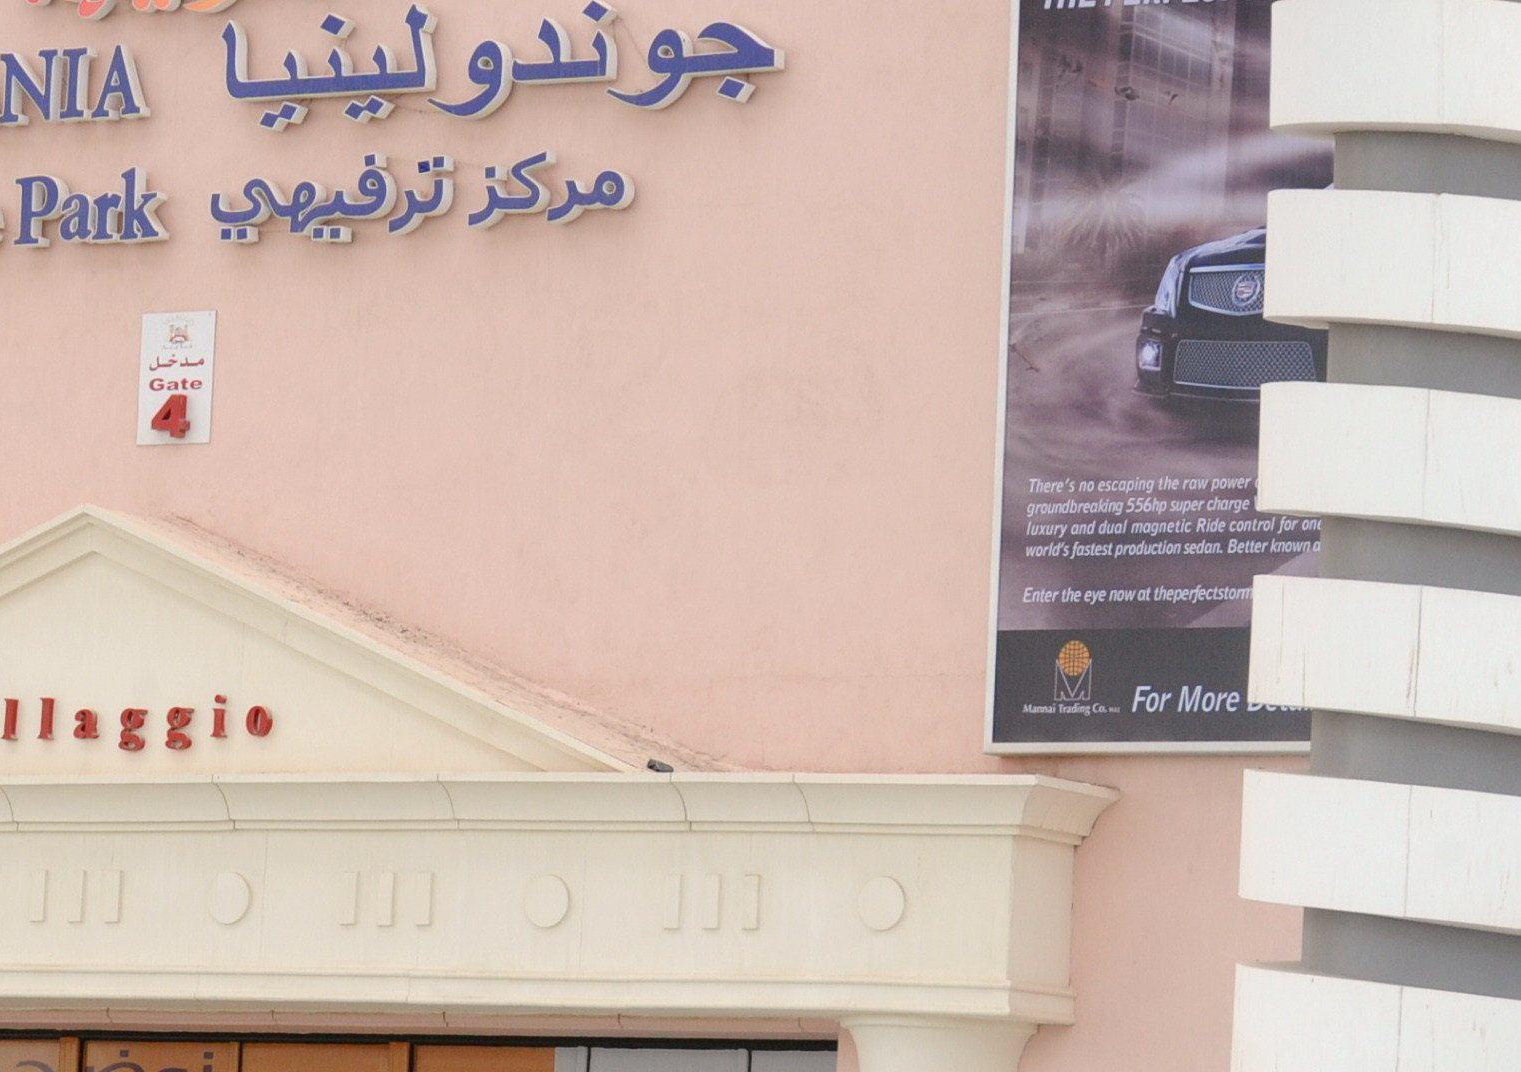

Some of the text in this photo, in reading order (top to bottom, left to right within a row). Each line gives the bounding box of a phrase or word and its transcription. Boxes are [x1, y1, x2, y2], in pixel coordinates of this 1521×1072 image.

[222, 0, 782, 129] جوندولينيا
[210, 150, 634, 242] مركز ترفيهي
[14, 168, 168, 248] Park
[149, 354, 205, 371] مدخل
[149, 378, 203, 391] Gate
[151, 394, 191, 438] 4
[1029, 478, 1075, 494] There's
[1079, 480, 1095, 492] no
[1098, 476, 1154, 496] escaping
[1158, 476, 1179, 490] the
[1183, 478, 1209, 490] raw
[1211, 477, 1251, 492] power
[1027, 498, 1123, 518] groundbreaking
[1126, 496, 1167, 515] 556hp
[1170, 496, 1204, 514] super
[1207, 495, 1249, 512] charge
[1027, 521, 1067, 538] luxury
[1071, 520, 1095, 535] and
[1098, 518, 1127, 534] dual
[1131, 518, 1191, 536] magnetic
[1196, 518, 1225, 532] Ride
[1229, 517, 1275, 532] control
[1278, 516, 1298, 534] for
[1026, 541, 1069, 558] world's
[1071, 542, 1112, 559] fastest
[1115, 541, 1179, 558] production
[1183, 540, 1223, 554] sedan.
[1228, 539, 1268, 554] Better
[1270, 539, 1311, 552] known
[1023, 588, 1059, 602] Enter
[1061, 588, 1081, 601] the
[1083, 591, 1105, 606] eye
[1109, 590, 1135, 602] now
[1137, 588, 1150, 601] at
[1022, 703, 1107, 716] Mannai Trading Co.
[1132, 686, 1171, 712] For
[1178, 685, 1239, 712] More
